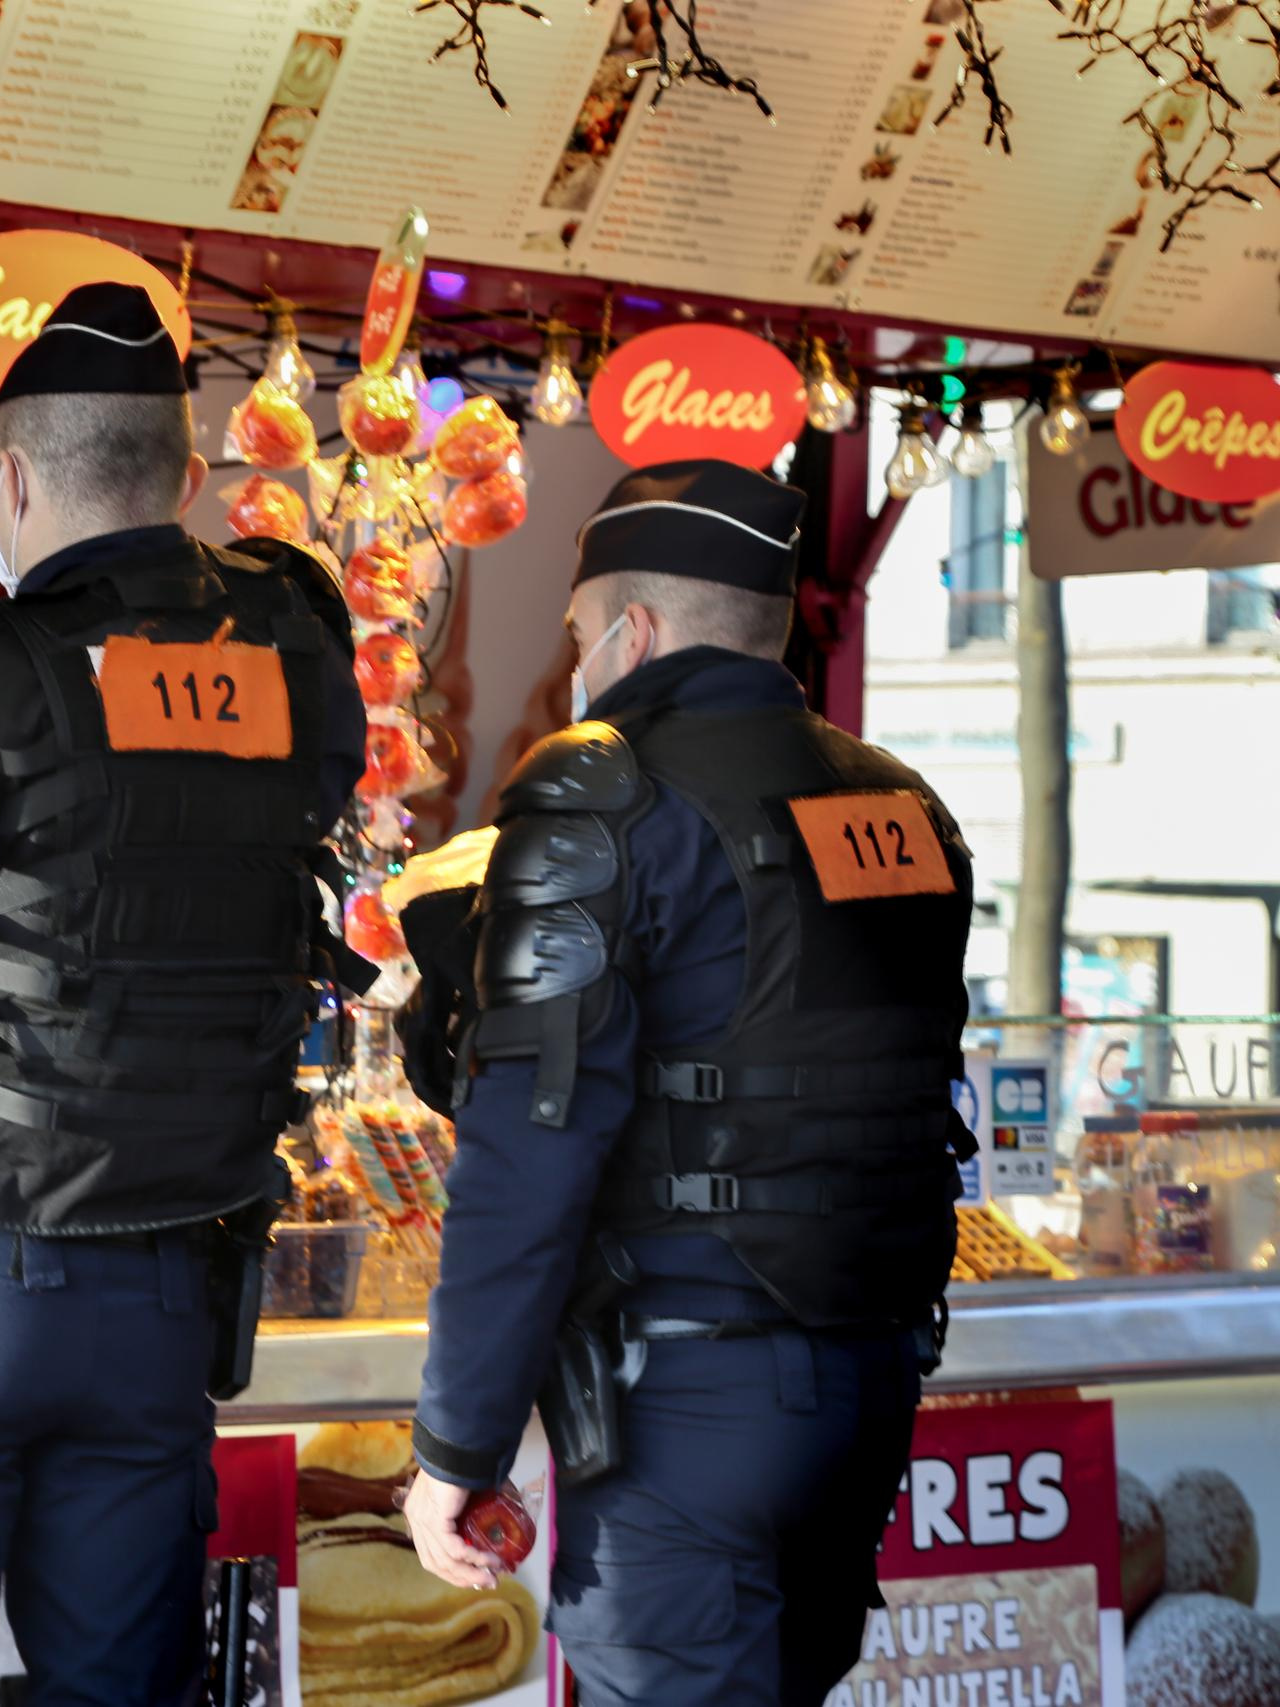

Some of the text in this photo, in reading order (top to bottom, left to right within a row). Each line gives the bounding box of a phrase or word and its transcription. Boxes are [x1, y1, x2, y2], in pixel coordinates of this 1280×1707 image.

[621, 360, 774, 445] Glaces
[150, 671, 240, 723] 112
[842, 819, 915, 870] 112
[996, 1078, 1043, 1113] CB
[888, 1451, 1070, 1551] RES
[862, 1599, 1021, 1663] AUFRE
[902, 1662, 1083, 1707] NUTELLA
